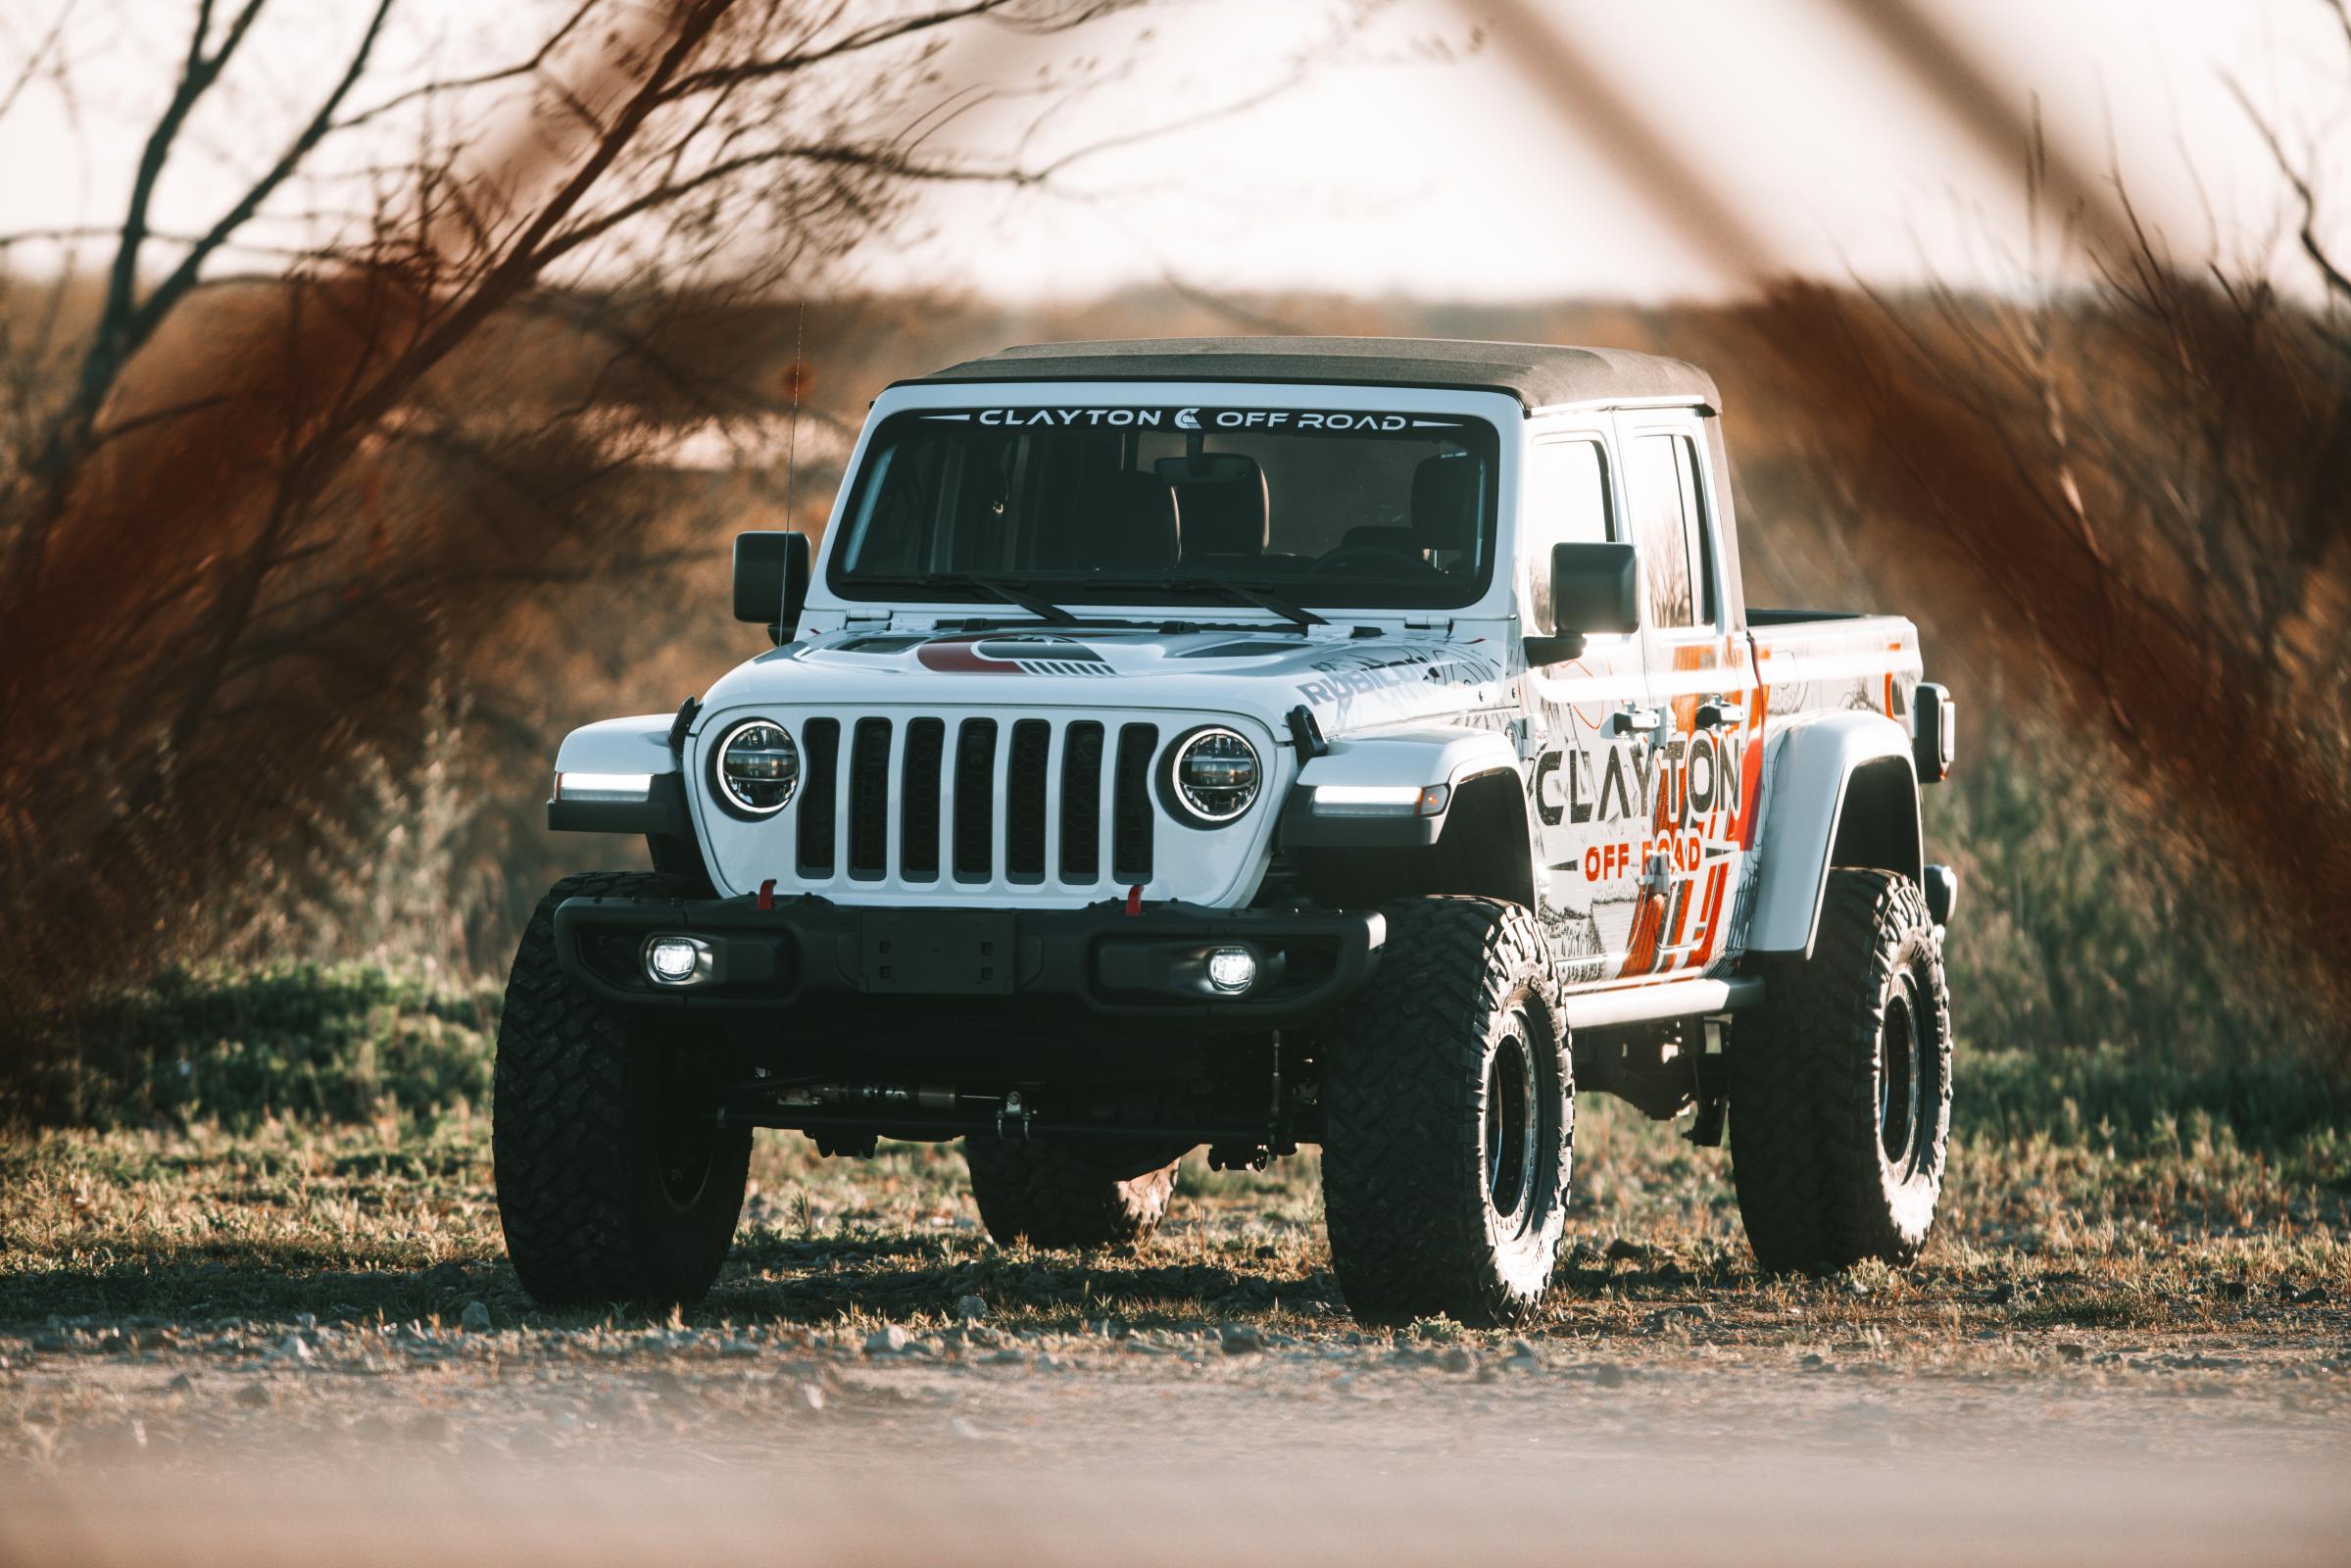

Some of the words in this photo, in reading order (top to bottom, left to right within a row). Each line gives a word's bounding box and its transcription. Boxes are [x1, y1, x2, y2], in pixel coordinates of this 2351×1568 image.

[979, 409, 1162, 425] CLAYTON
[1216, 412, 1291, 427] OFF
[1297, 413, 1407, 431] ROAD
[1536, 737, 1739, 827] CLAYTON
[1585, 842, 1630, 882] OFF
